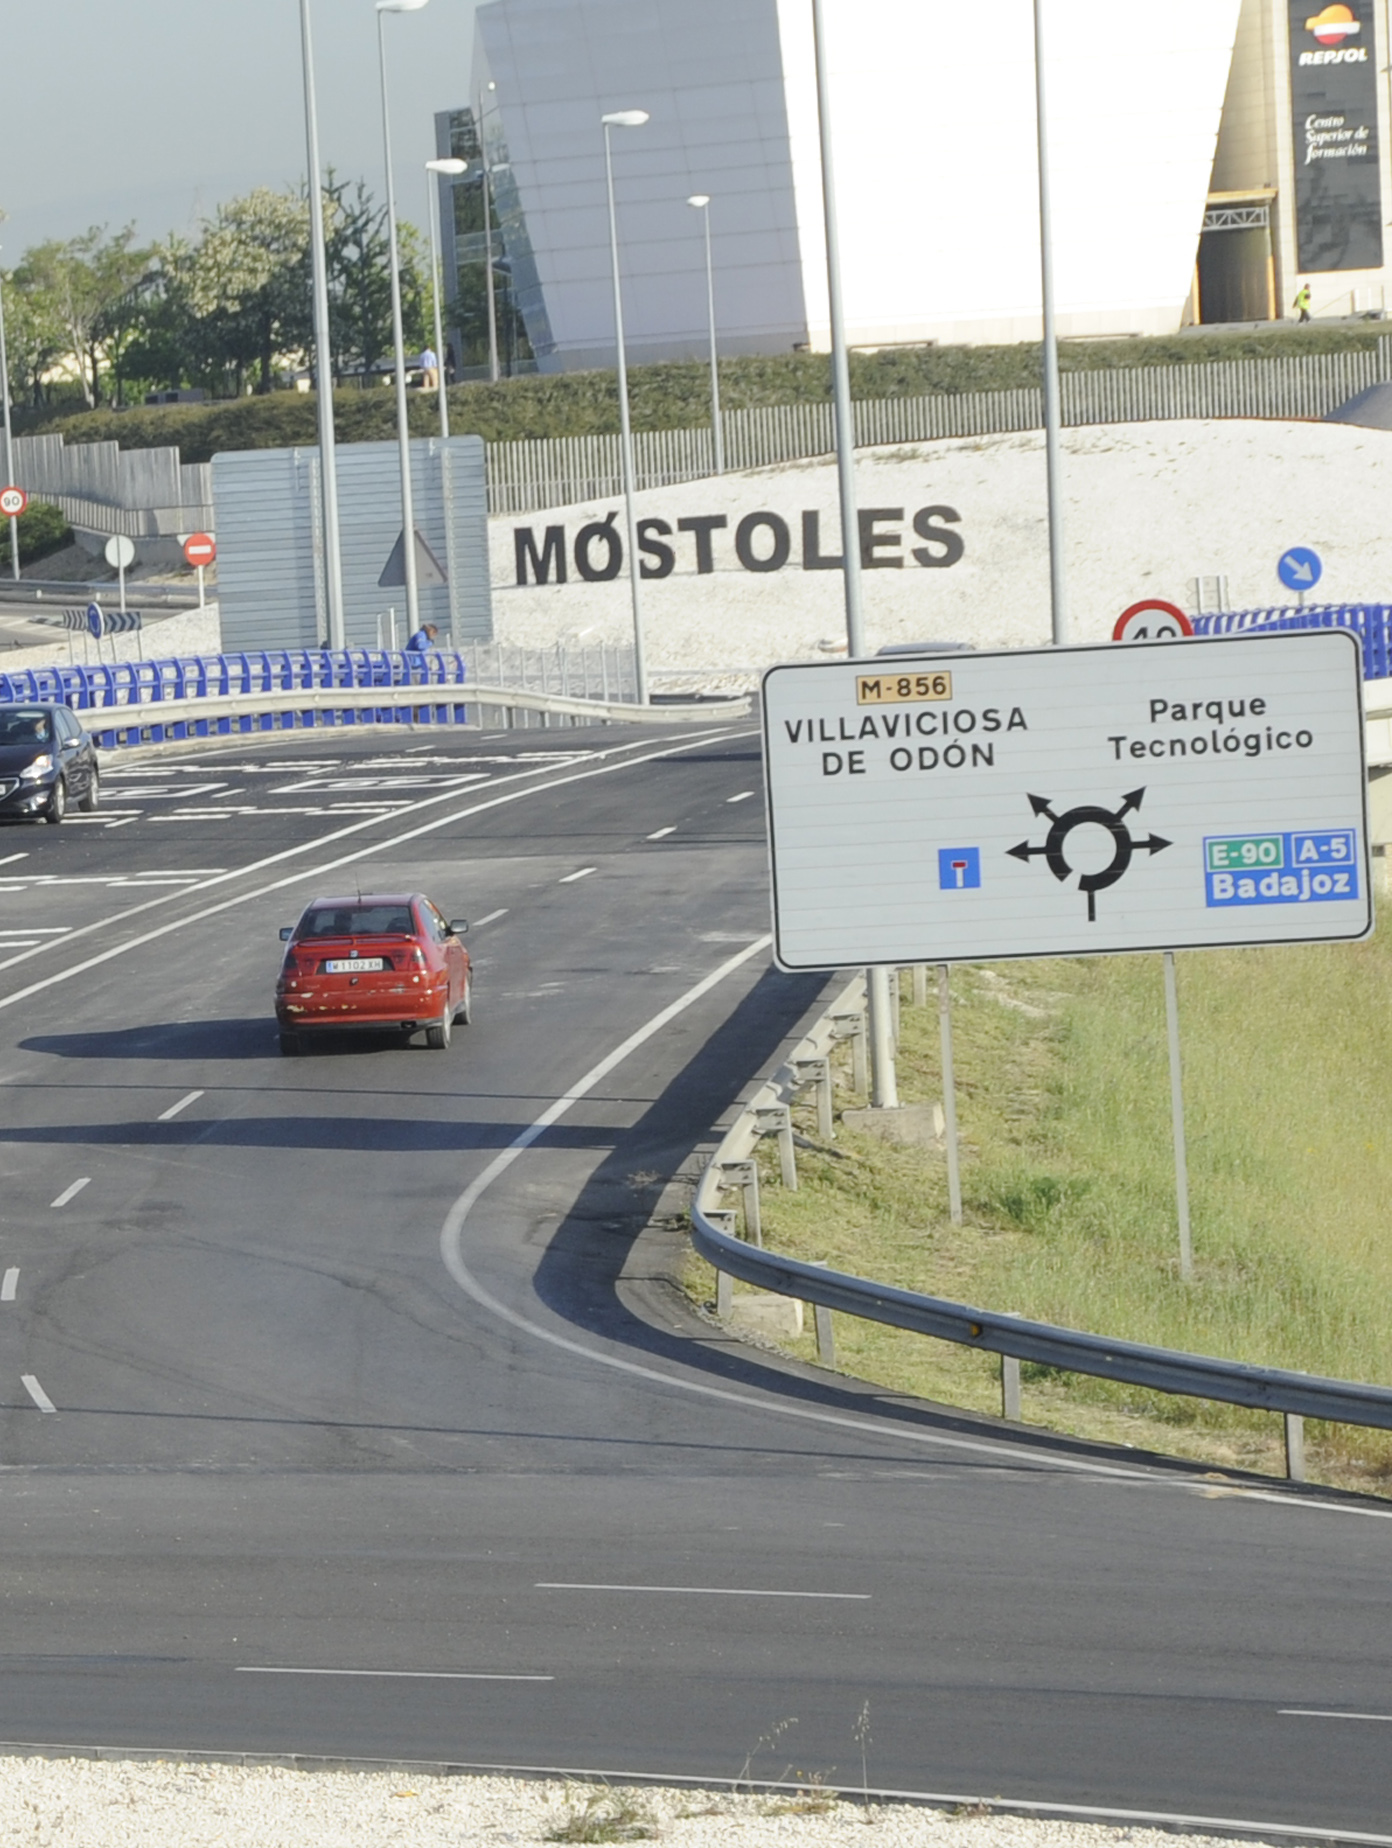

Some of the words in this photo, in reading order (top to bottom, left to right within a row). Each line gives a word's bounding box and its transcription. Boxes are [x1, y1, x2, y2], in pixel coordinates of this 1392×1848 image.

[1298, 47, 1368, 66] REPSOL
[1305, 114, 1345, 130] Centro
[1305, 129, 1354, 146] Superior
[1354, 126, 1369, 139] de
[1304, 142, 1368, 165] formación
[513, 504, 965, 586] MÓSTOLES
[861, 675, 947, 700] M-856
[1149, 697, 1267, 724] Parque
[784, 706, 1028, 744] VILLAVICIOSA
[822, 751, 866, 776] DE
[889, 739, 995, 772] ODÓN
[1107, 727, 1313, 761] Tecnológico
[1211, 842, 1278, 867] E-90
[1298, 837, 1348, 861] A-5
[1211, 869, 1351, 902] Badajoz
[341, 962, 366, 971] 1102
